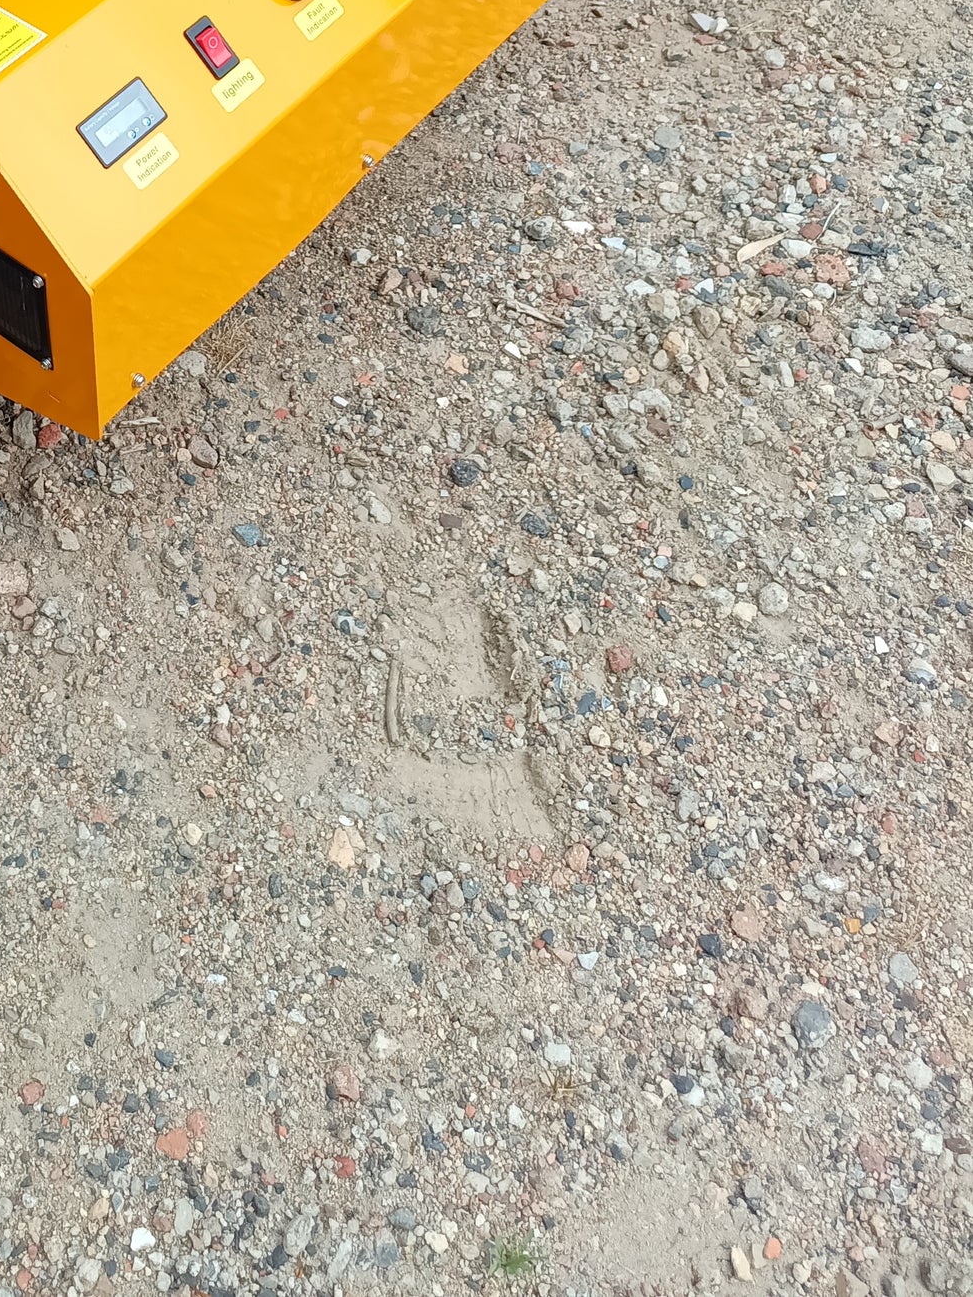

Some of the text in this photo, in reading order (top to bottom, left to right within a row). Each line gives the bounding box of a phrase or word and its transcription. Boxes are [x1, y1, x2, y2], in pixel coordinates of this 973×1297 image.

[306, 2, 325, 20] Fault
[306, 5, 338, 35] Indication
[222, 70, 255, 99] lighting
[136, 144, 159, 167] Power
[137, 150, 172, 182] Indication
